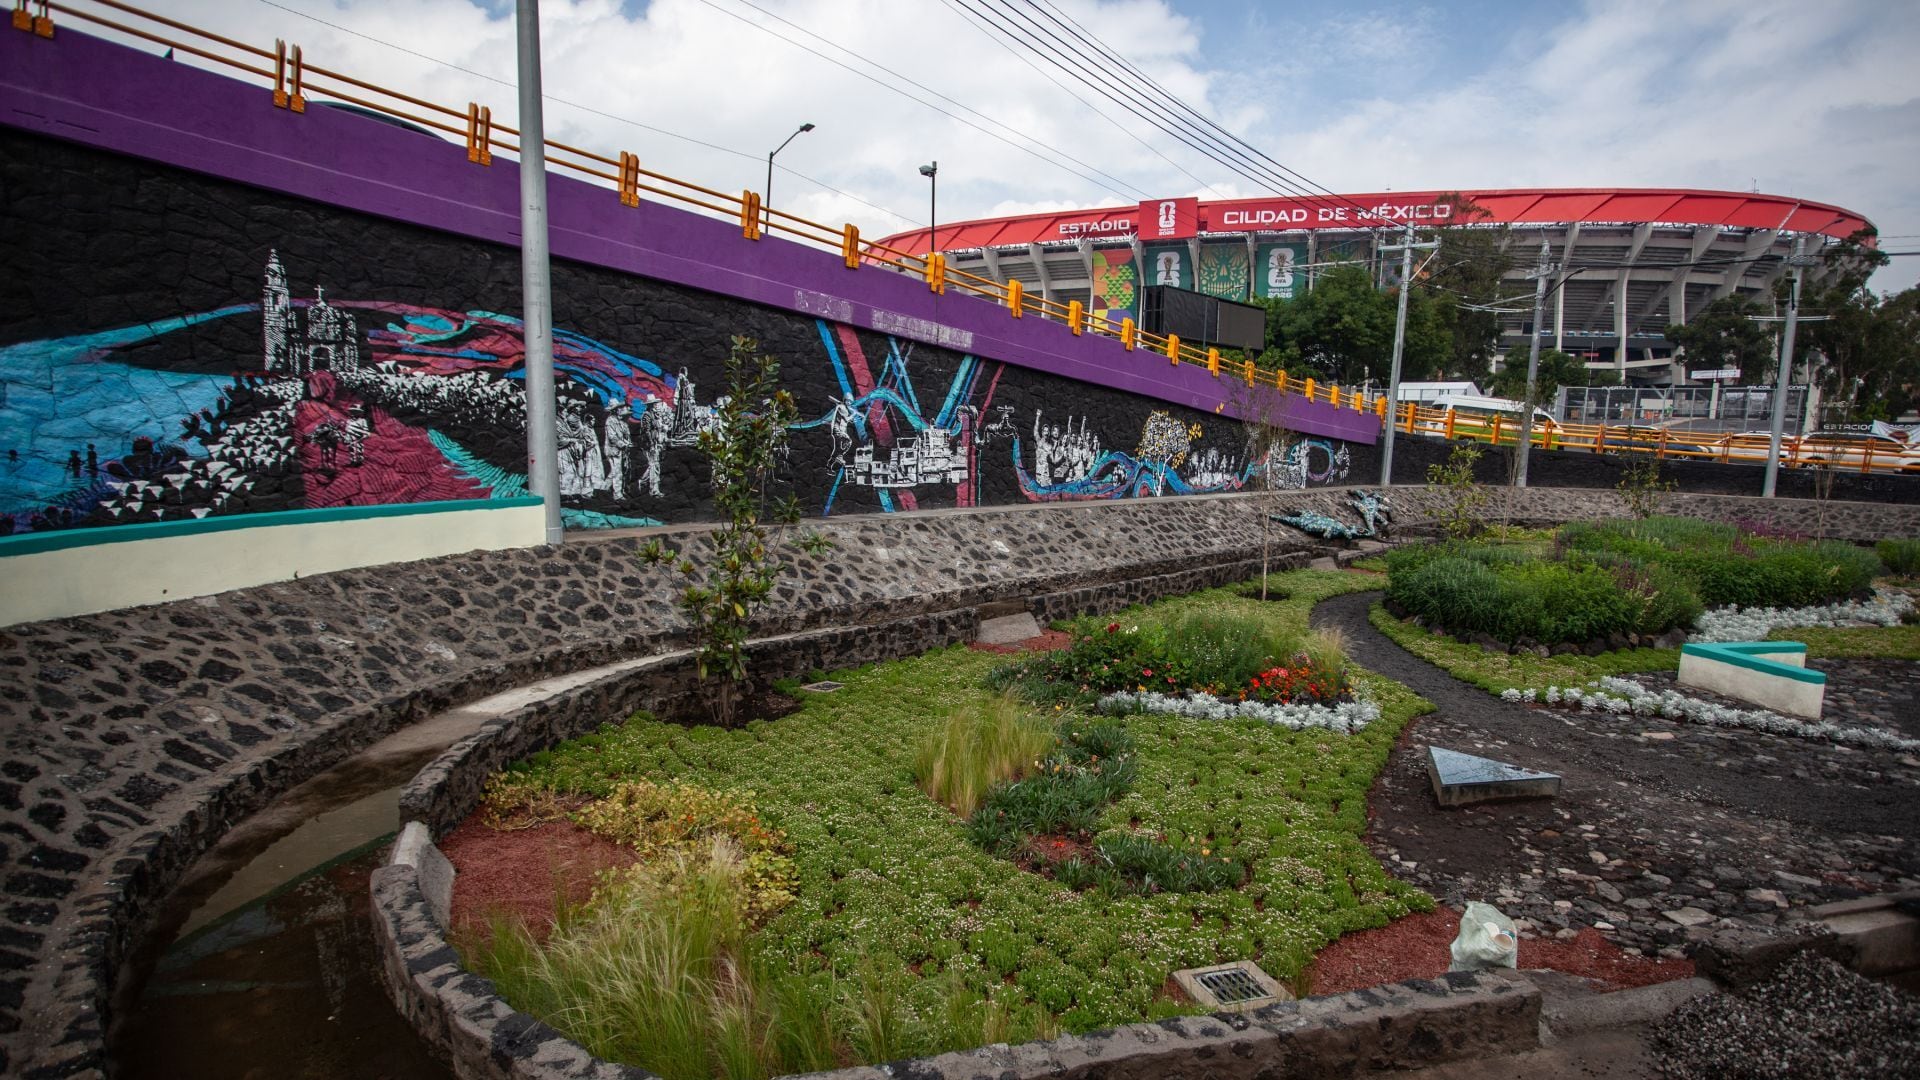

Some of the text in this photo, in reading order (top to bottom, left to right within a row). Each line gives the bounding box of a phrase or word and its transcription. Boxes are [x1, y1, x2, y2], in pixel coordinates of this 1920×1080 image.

[1223, 202, 1451, 225] CIUDAD DE MÉXICO
[1059, 220, 1130, 234] ESTADIO
